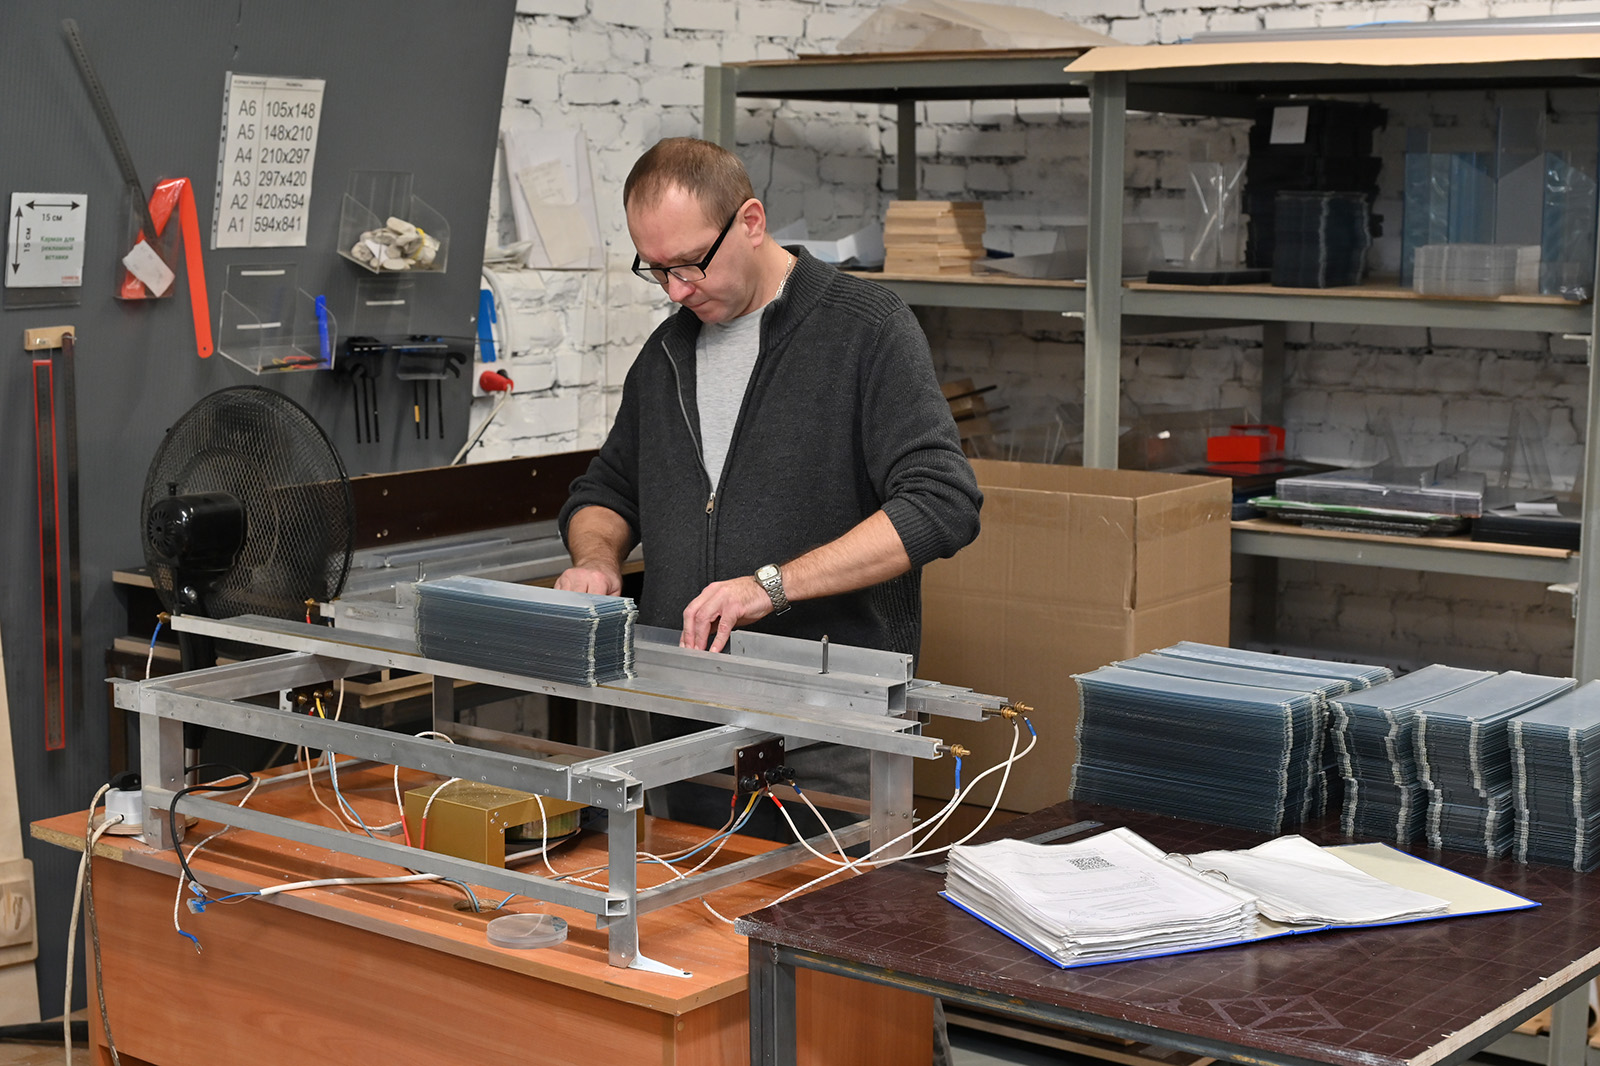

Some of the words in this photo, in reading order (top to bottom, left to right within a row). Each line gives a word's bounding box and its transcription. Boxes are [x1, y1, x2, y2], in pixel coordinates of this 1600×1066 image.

[238, 100, 257, 116] A6
[266, 101, 316, 118] 105x148
[237, 124, 255, 140] A5
[264, 125, 313, 142] 148x210
[234, 147, 252, 163] A4
[261, 148, 310, 164] 210x297
[233, 170, 251, 186] A3
[258, 171, 307, 187] 297x420
[230, 194, 247, 210] A2
[255, 194, 305, 210] 420x594
[42, 214, 51, 222] 15
[228, 217, 244, 232] A1
[254, 216, 301, 232] 594x841
[25, 228, 31, 240] см
[24, 242, 30, 252] 15
